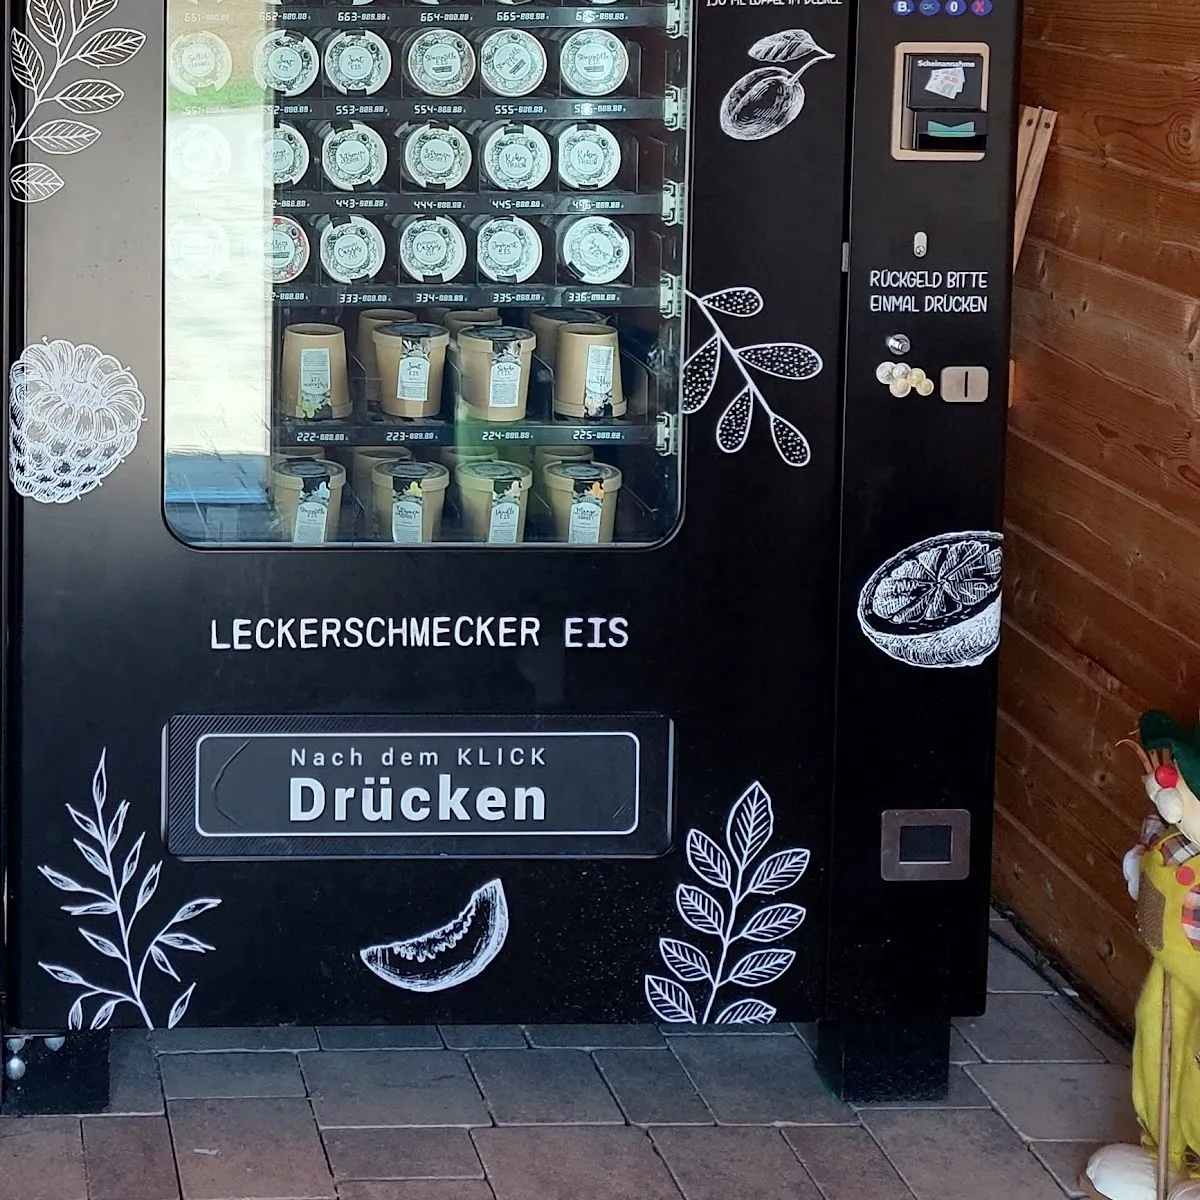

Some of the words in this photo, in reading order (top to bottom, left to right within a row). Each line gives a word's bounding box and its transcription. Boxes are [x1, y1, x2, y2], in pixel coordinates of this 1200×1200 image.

[950, 1, 958, 13] 0
[917, 60, 976, 68] Scheinannahme
[947, 271, 988, 289] BITTE
[870, 295, 920, 312] EINMAL
[210, 616, 540, 650] LECKERSCHMECKER
[564, 617, 629, 648] EIS
[290, 747, 363, 766] Nach
[381, 747, 440, 766] dem
[457, 747, 546, 766] KLICK
[289, 774, 545, 823] Drücken
